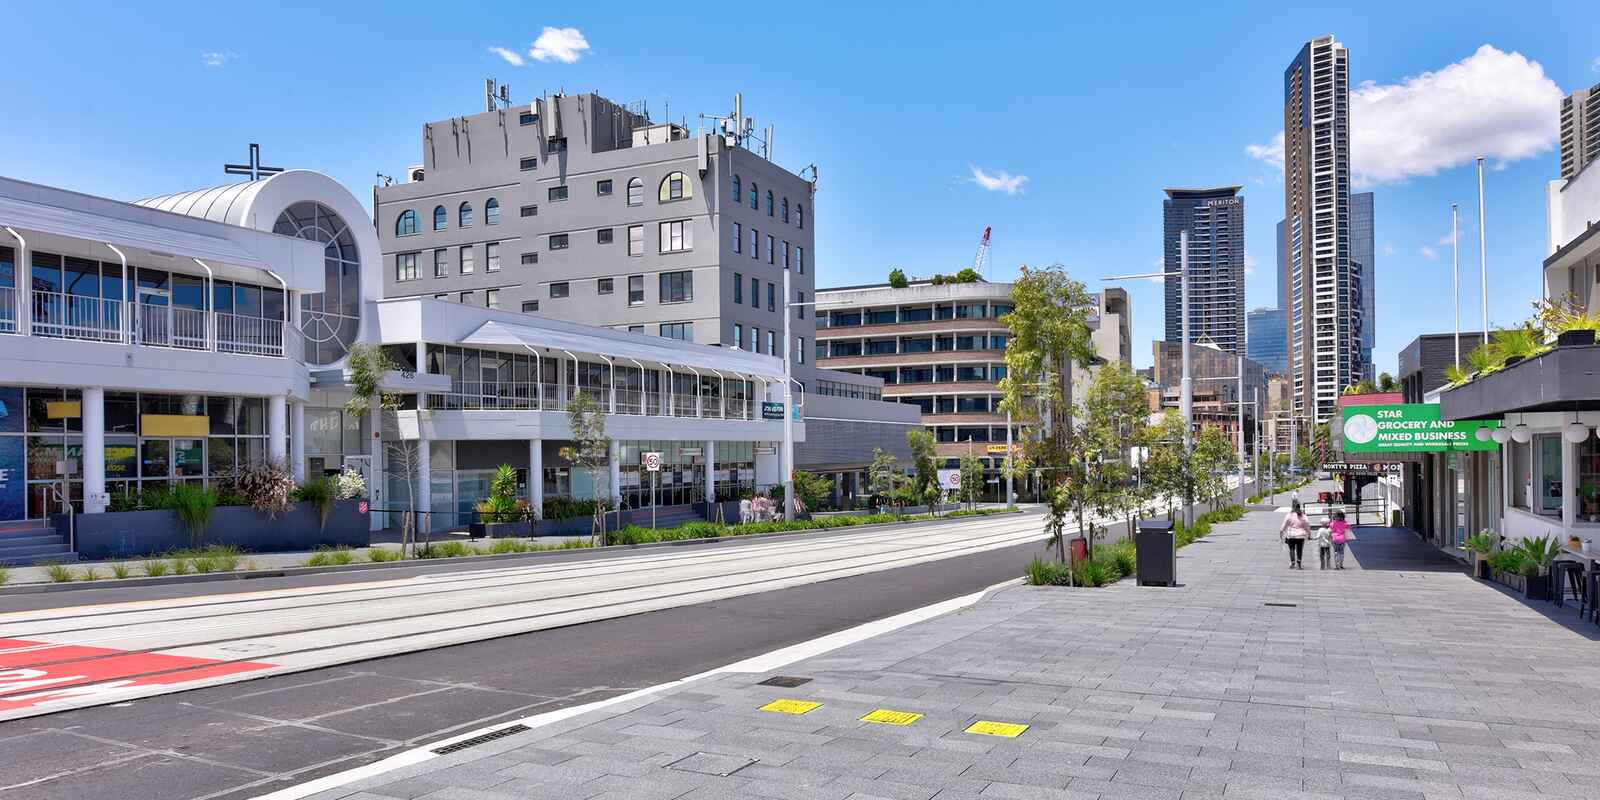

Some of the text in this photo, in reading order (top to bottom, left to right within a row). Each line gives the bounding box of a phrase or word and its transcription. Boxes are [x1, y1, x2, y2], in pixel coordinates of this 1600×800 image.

[1377, 410, 1403, 418] STAR
[1378, 420, 1455, 429] GROCERY AND
[1378, 431, 1467, 440] MIXED BUSINESS
